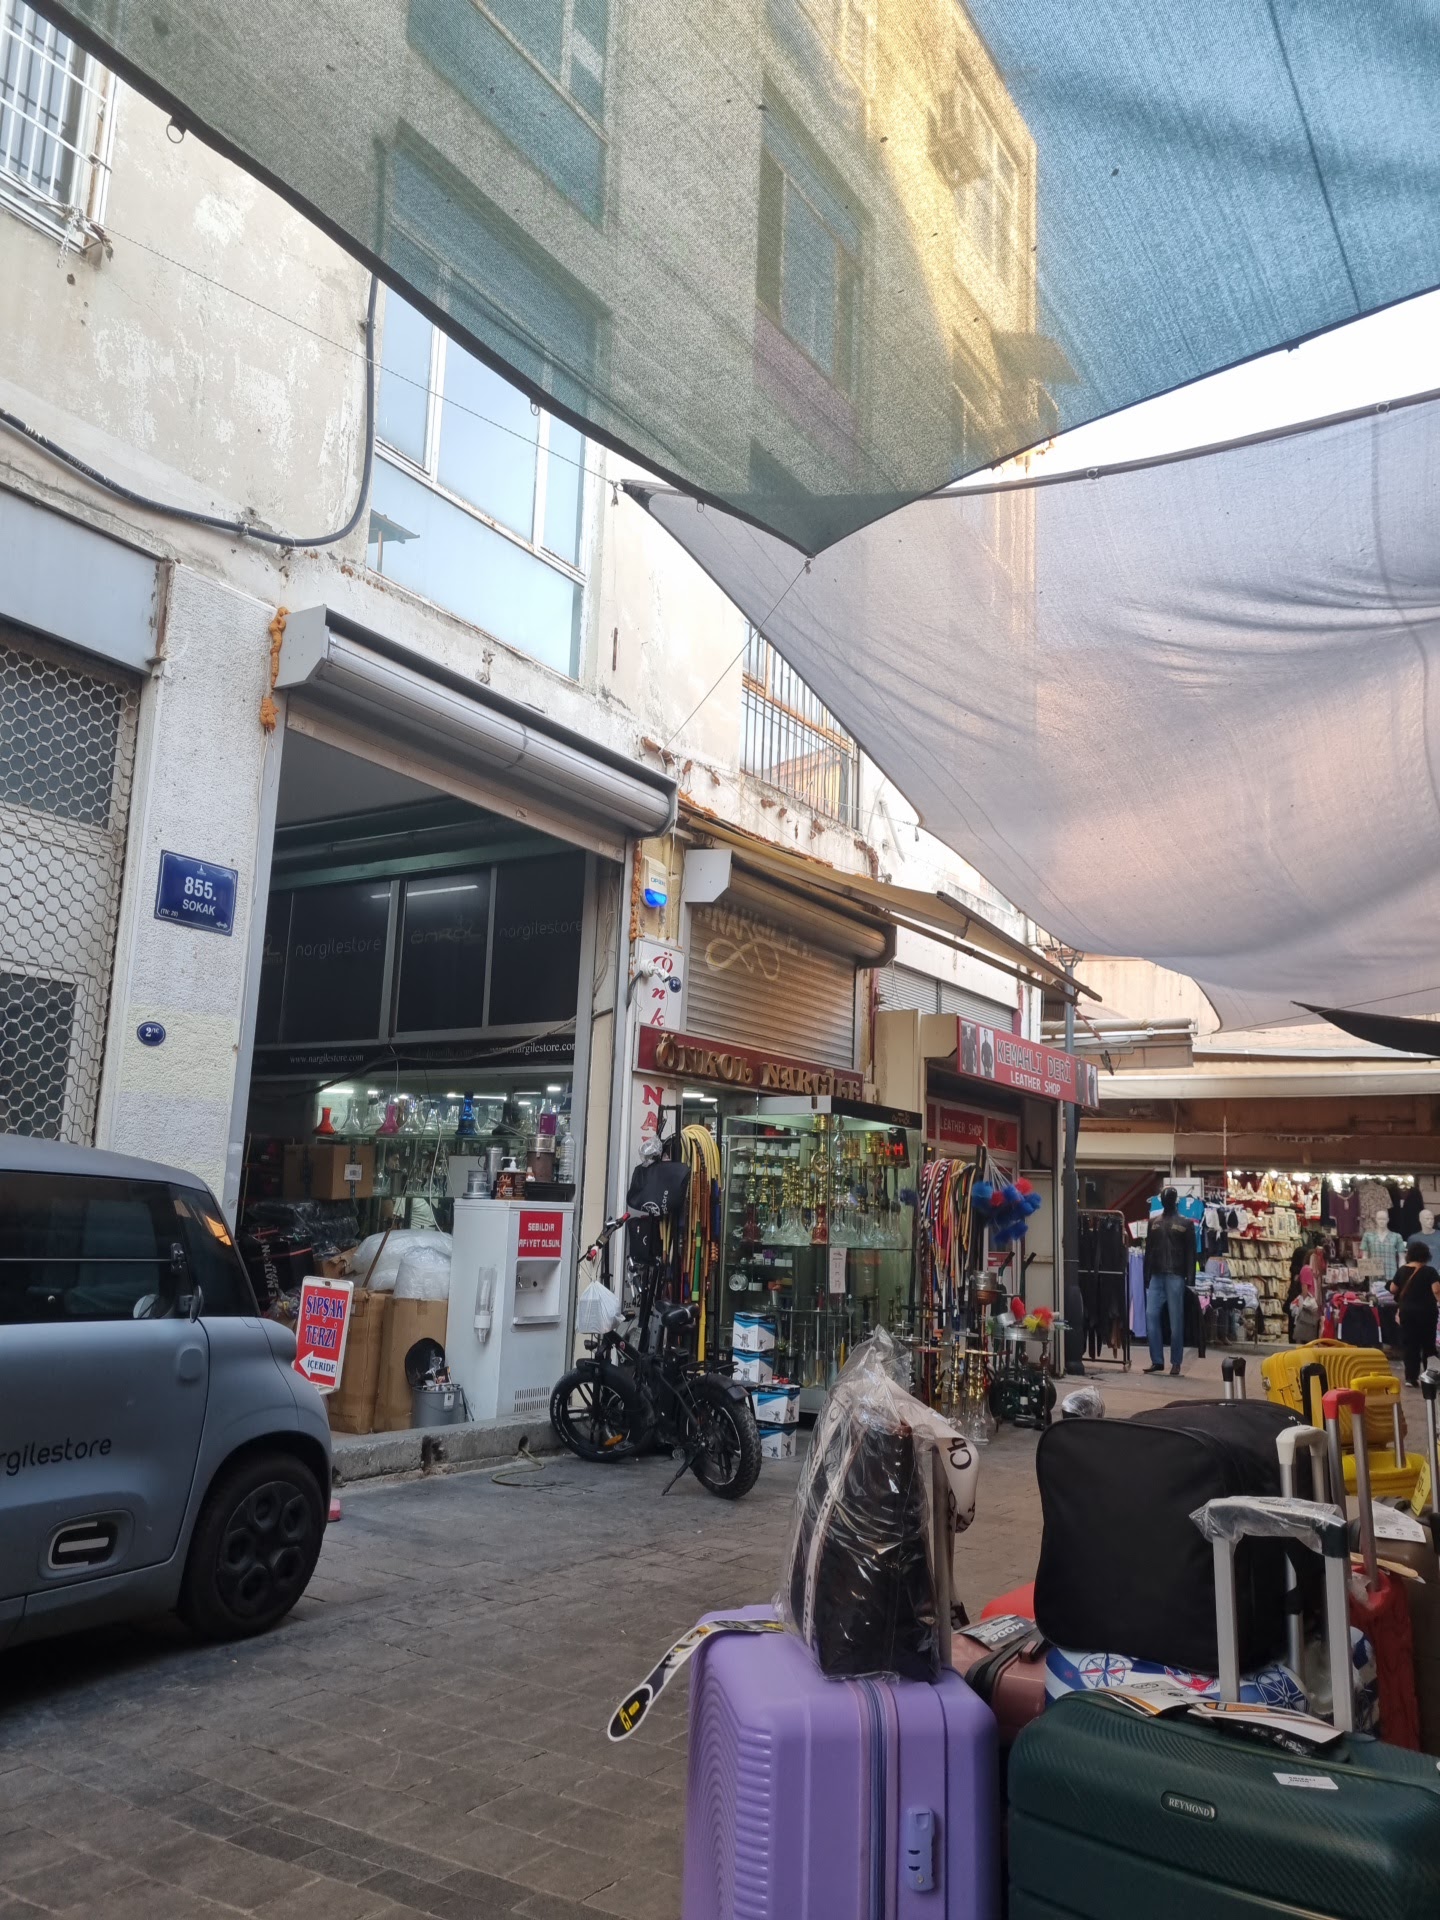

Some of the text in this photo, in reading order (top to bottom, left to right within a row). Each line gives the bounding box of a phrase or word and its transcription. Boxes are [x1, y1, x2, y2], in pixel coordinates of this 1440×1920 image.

[184, 876, 217, 901] 855.
[182, 899, 216, 916] SOKAK
[295, 937, 382, 960] nargilestore
[289, 1053, 364, 1065] www.nargilestore.com
[655, 1032, 753, 1084] ÖNKOL
[996, 1038, 1072, 1084] KEMAHLI DERİ
[1010, 1070, 1061, 1096] LEATHER SHOP
[940, 1118, 983, 1137] LEATHER SHOP
[305, 1288, 346, 1324] ŞİPŞAK
[305, 1322, 338, 1349] TERZİ
[307, 1356, 336, 1374] İÇERİDE
[1168, 1797, 1211, 1818] REYMOND
